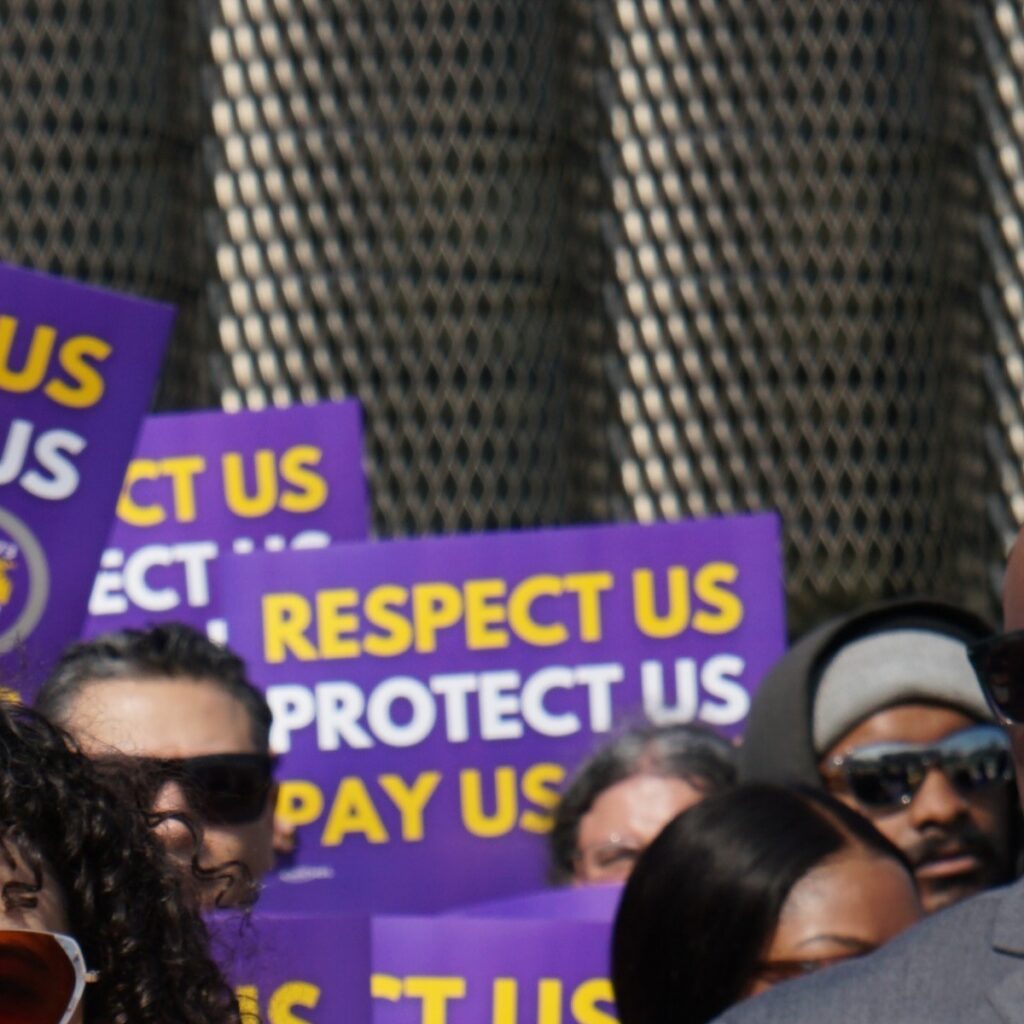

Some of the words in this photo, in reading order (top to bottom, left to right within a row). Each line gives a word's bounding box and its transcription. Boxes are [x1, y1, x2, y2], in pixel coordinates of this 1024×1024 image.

[222, 444, 328, 518] US
[261, 571, 614, 663] RESPECT
[633, 562, 744, 638] US
[264, 662, 626, 755] PROTECT
[640, 653, 751, 727] US
[274, 771, 441, 847] PAY
[459, 763, 566, 837] US
